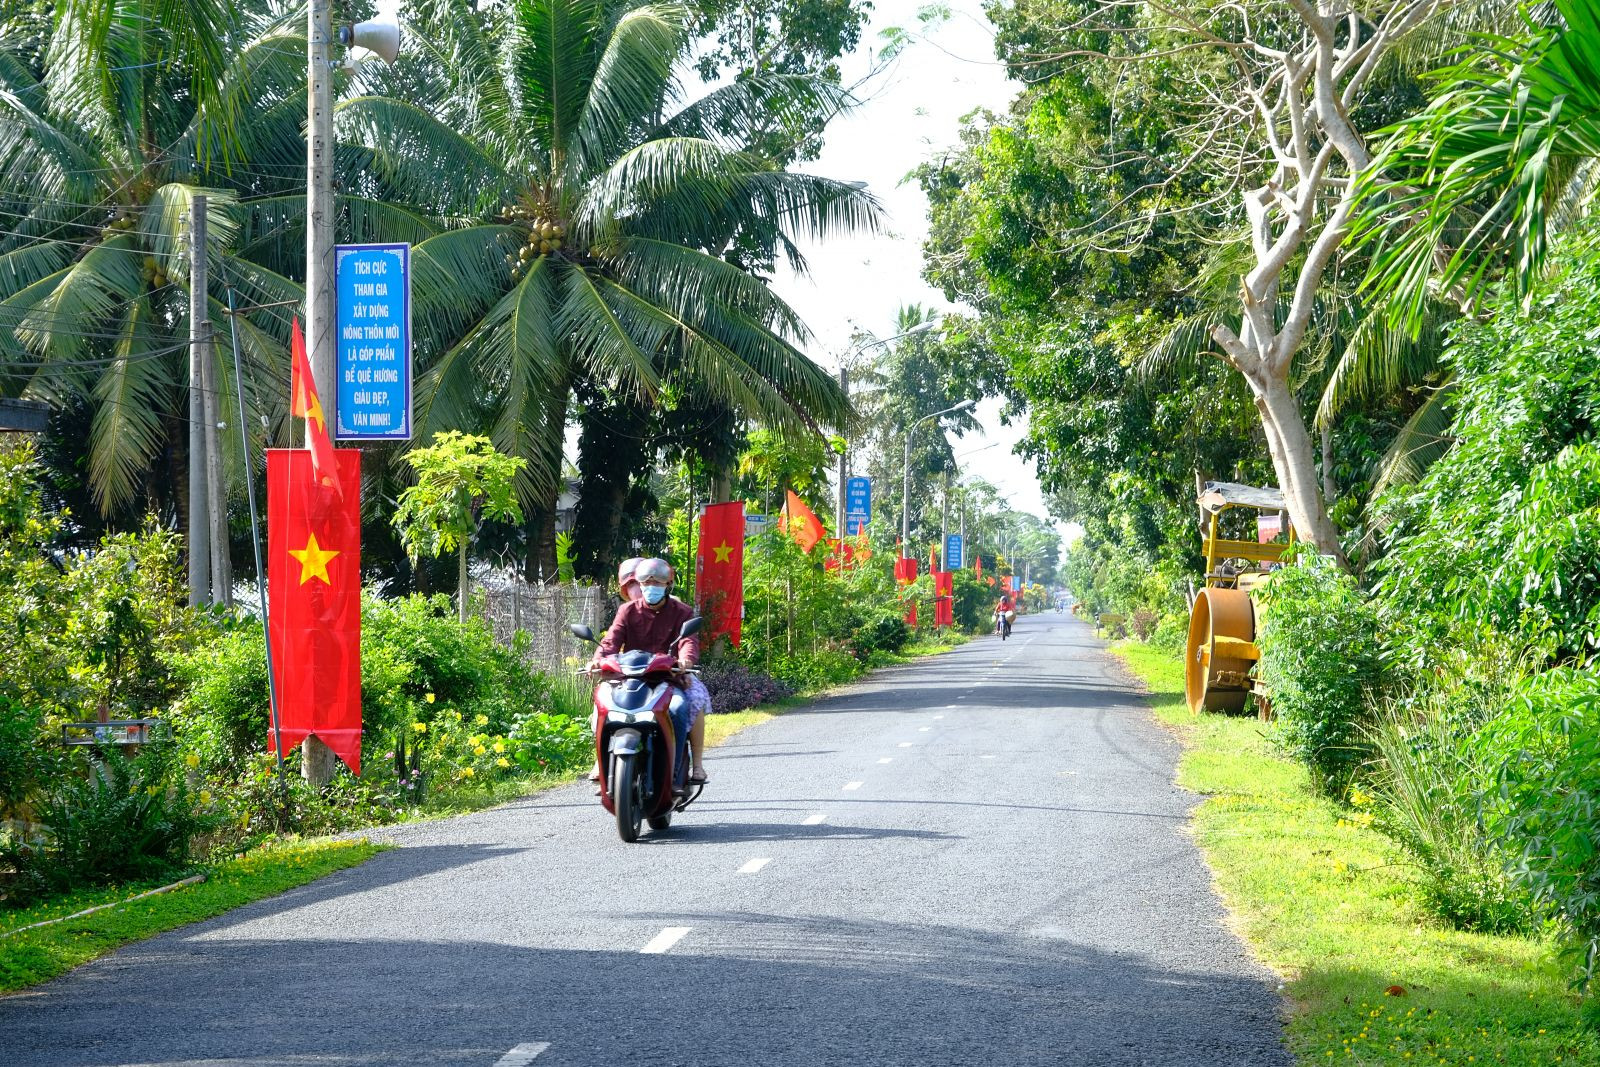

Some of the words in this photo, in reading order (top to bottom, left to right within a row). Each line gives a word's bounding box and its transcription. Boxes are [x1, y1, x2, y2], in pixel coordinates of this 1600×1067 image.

[354, 259, 370, 275] TÍCH
[372, 259, 386, 276] CỰC
[354, 284, 374, 296] THAM
[376, 283, 388, 296] GIA
[354, 302, 368, 318] XÂY
[370, 303, 388, 320] DỰNG
[344, 324, 362, 340] NÔNG
[364, 323, 384, 339] THÔN
[386, 323, 400, 339] MỚI
[348, 345, 357, 361] LÀ
[358, 345, 374, 361] GÓP
[357, 367, 372, 384] QUÊ
[374, 368, 398, 382] HƯƠNG
[354, 388, 370, 404] GIÀU
[352, 411, 368, 426] VĂN
[370, 413, 390, 426] MINH!
